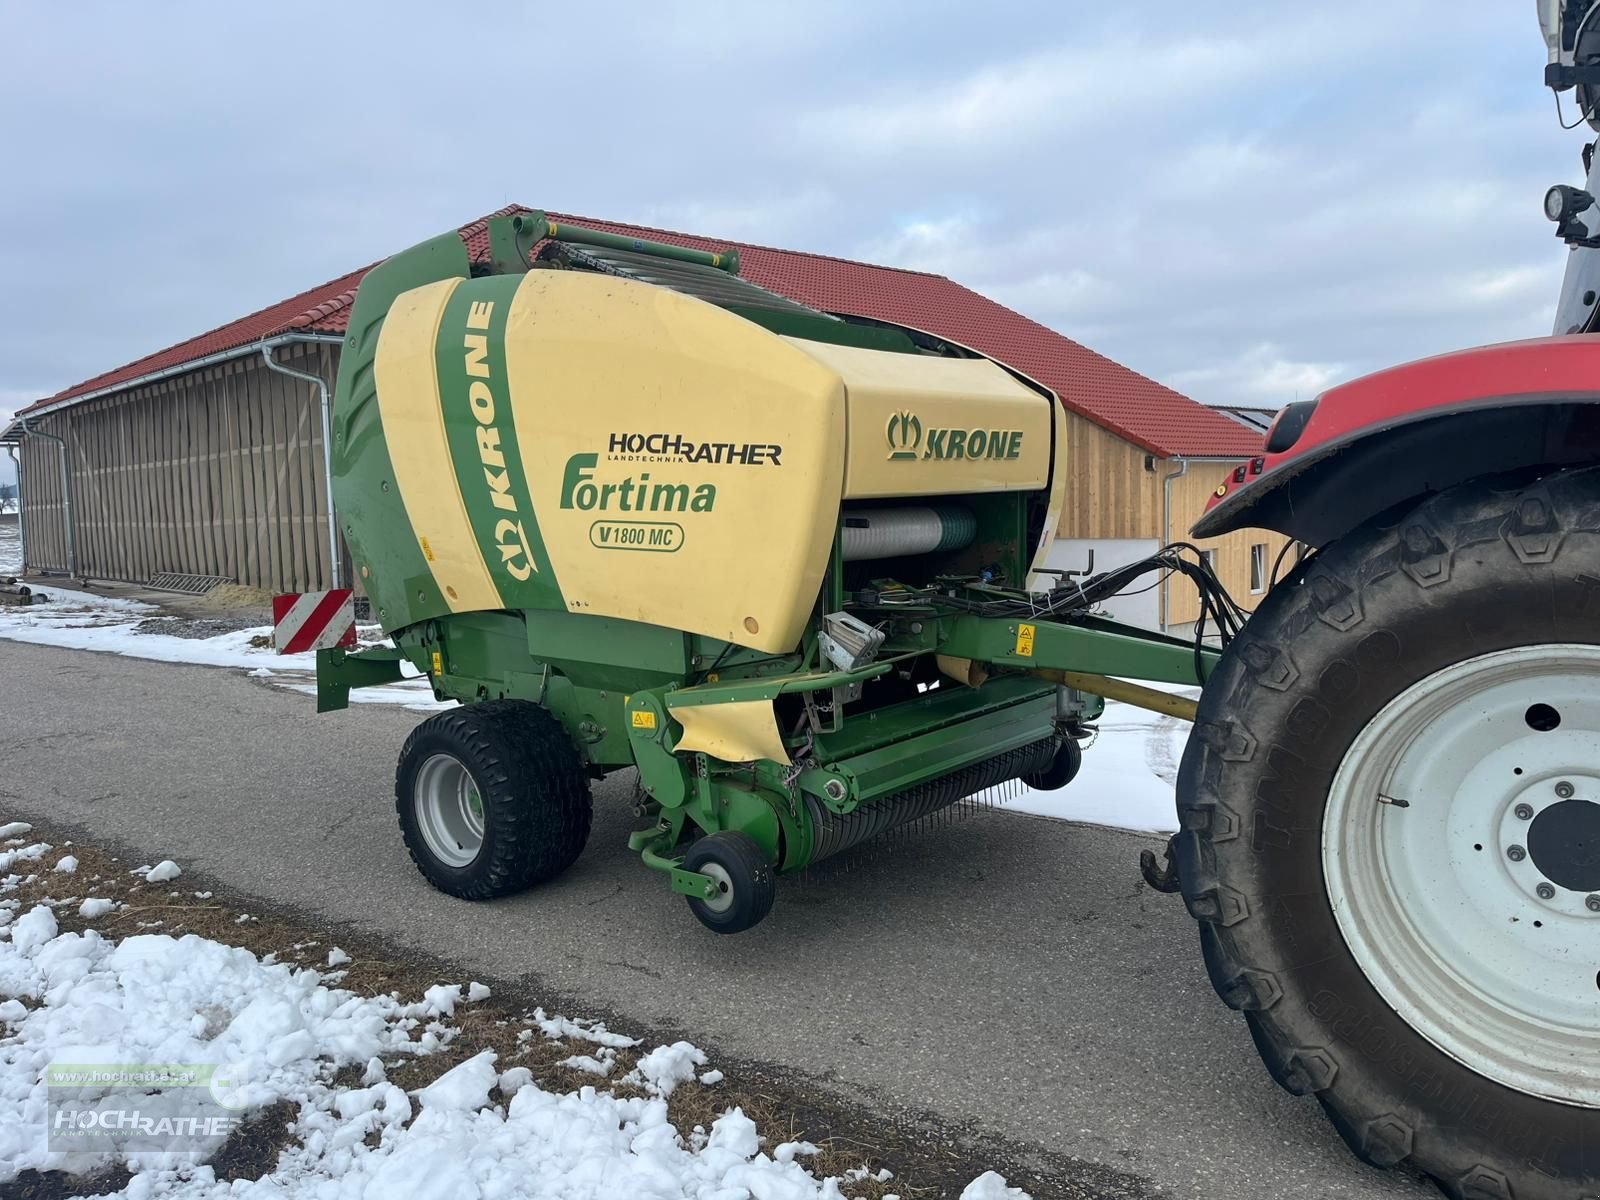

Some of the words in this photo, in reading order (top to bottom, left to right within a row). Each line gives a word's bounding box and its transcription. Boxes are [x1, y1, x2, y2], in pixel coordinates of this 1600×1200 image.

[464, 301, 517, 512] KRONE
[608, 432, 782, 466] HOCHRATHER
[608, 455, 684, 464] LANDTECHNIK
[924, 428, 1023, 462] KRONE
[560, 453, 716, 513] Fortima
[649, 529, 673, 546] MC
